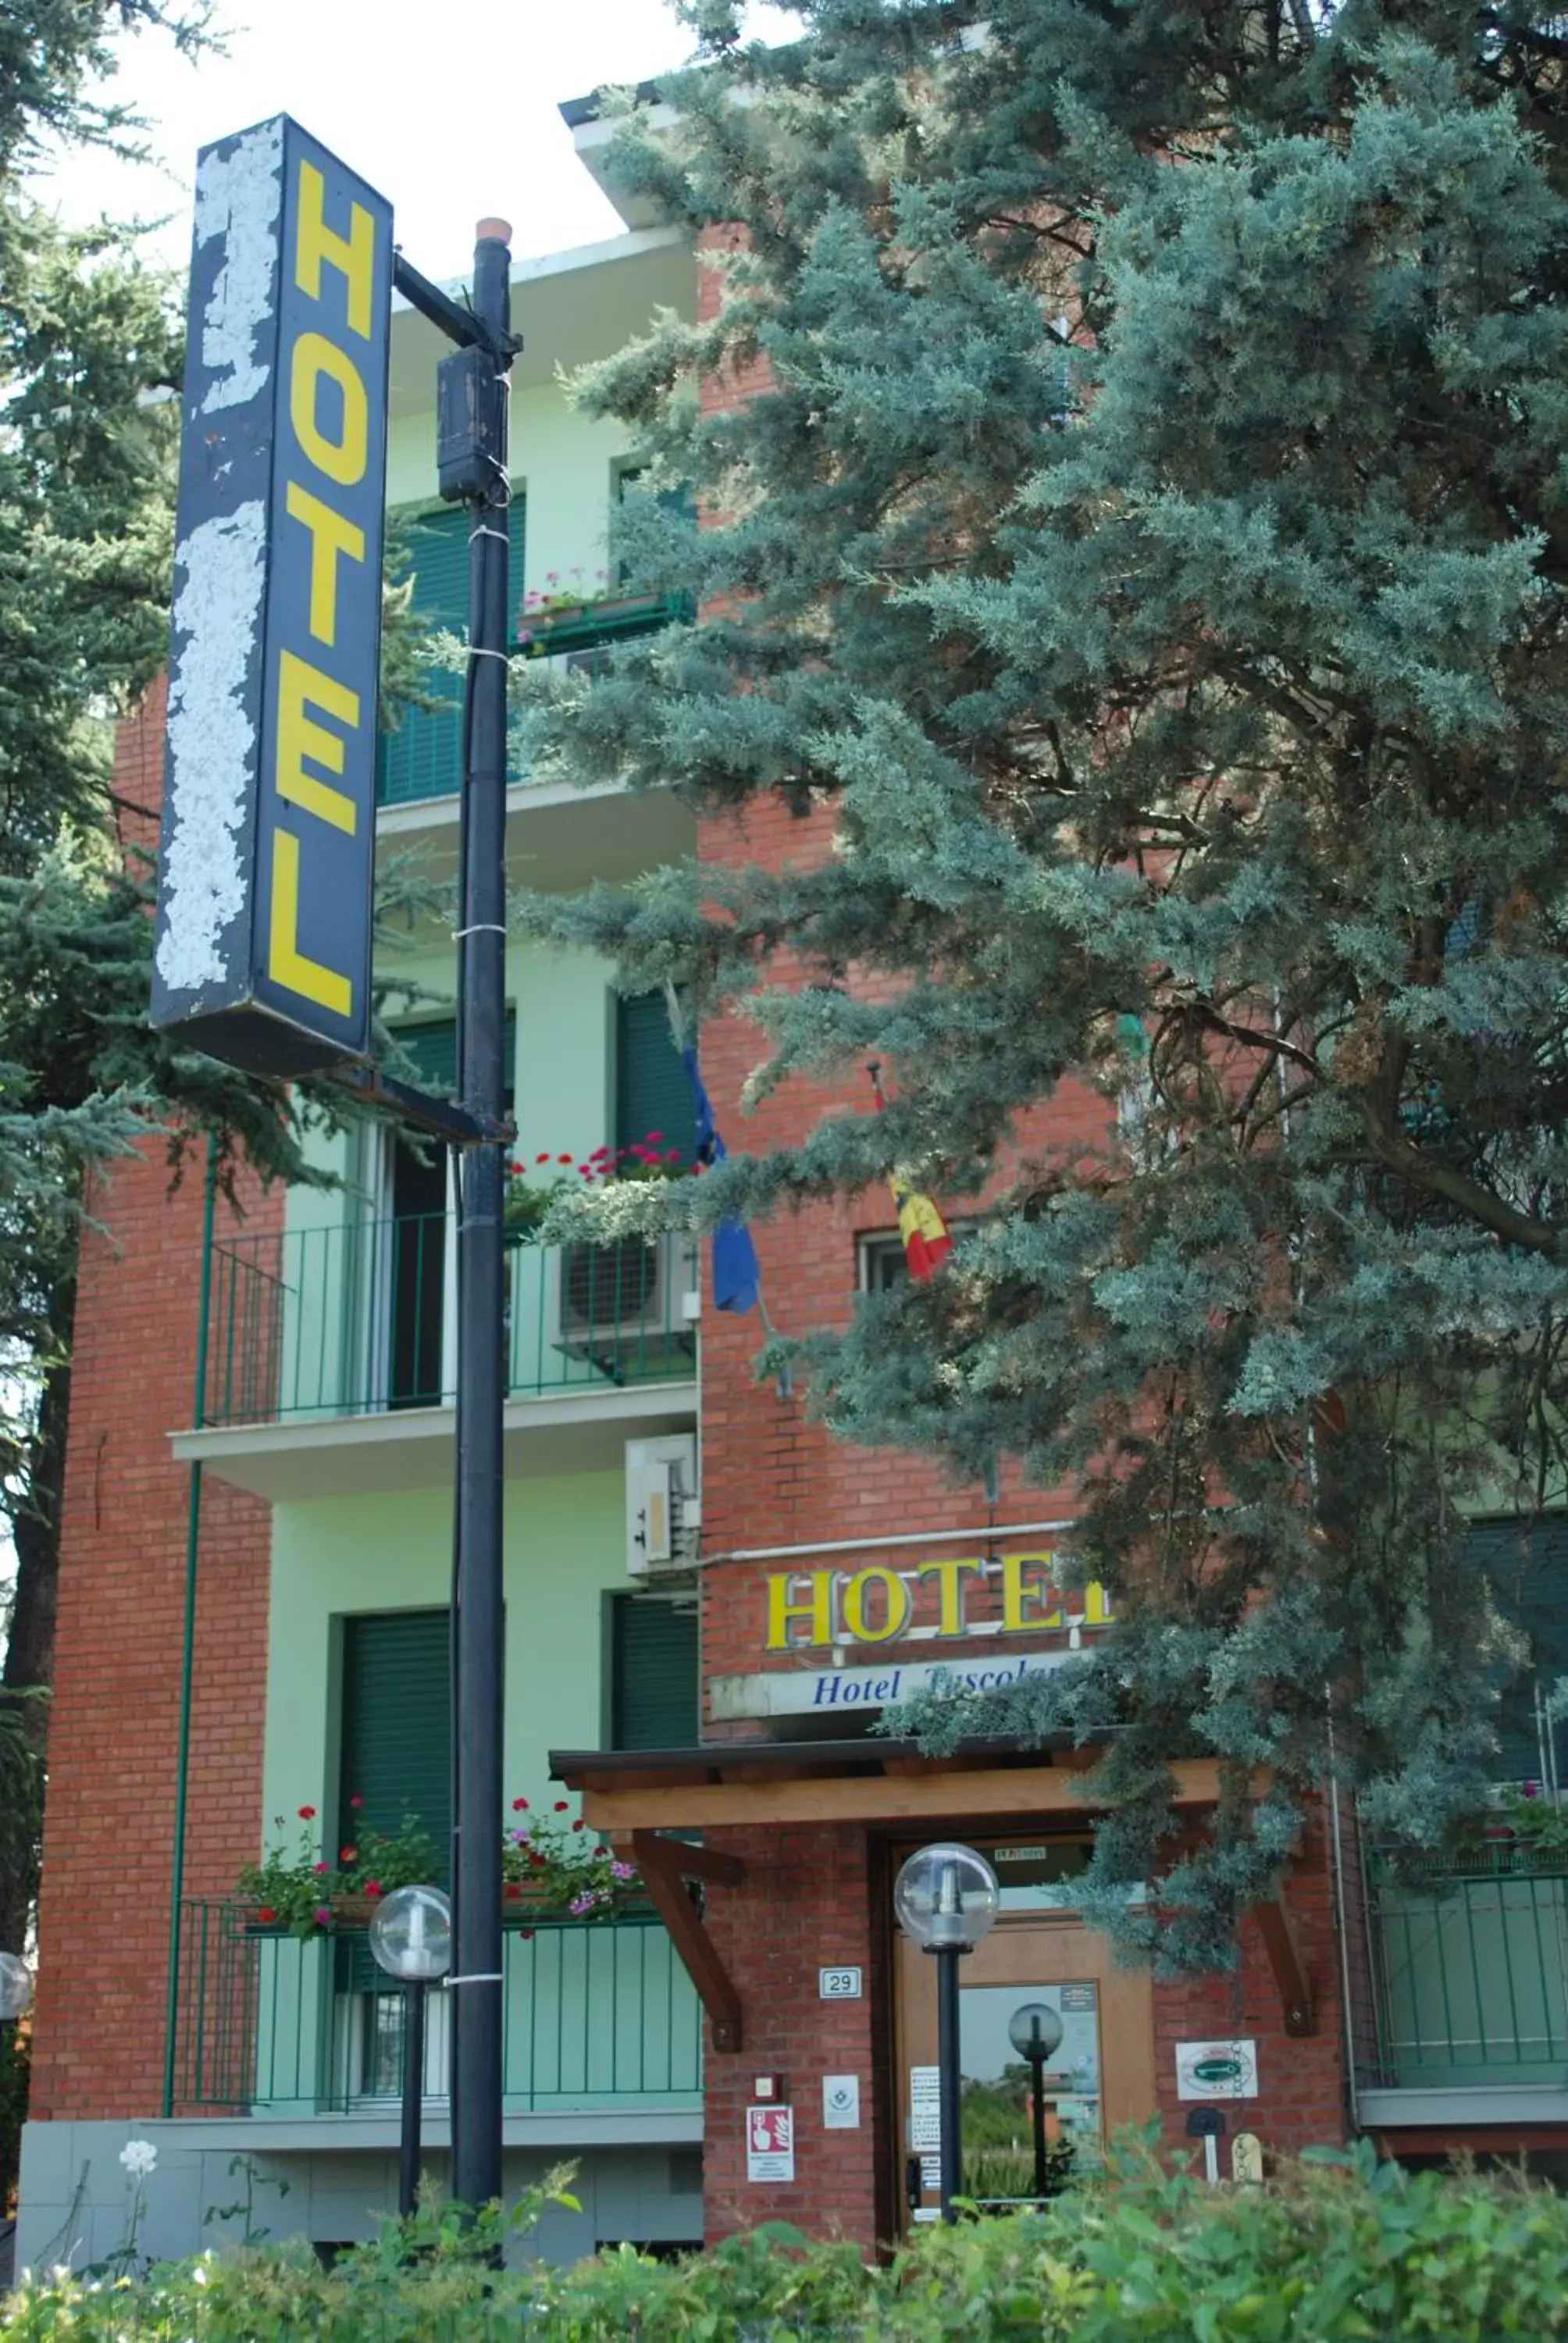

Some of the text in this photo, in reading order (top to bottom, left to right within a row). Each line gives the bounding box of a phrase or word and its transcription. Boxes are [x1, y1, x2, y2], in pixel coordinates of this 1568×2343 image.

[269, 159, 375, 1018] HOTEL
[813, 1671, 901, 1706] Hotel
[830, 1975, 851, 1991] 29
